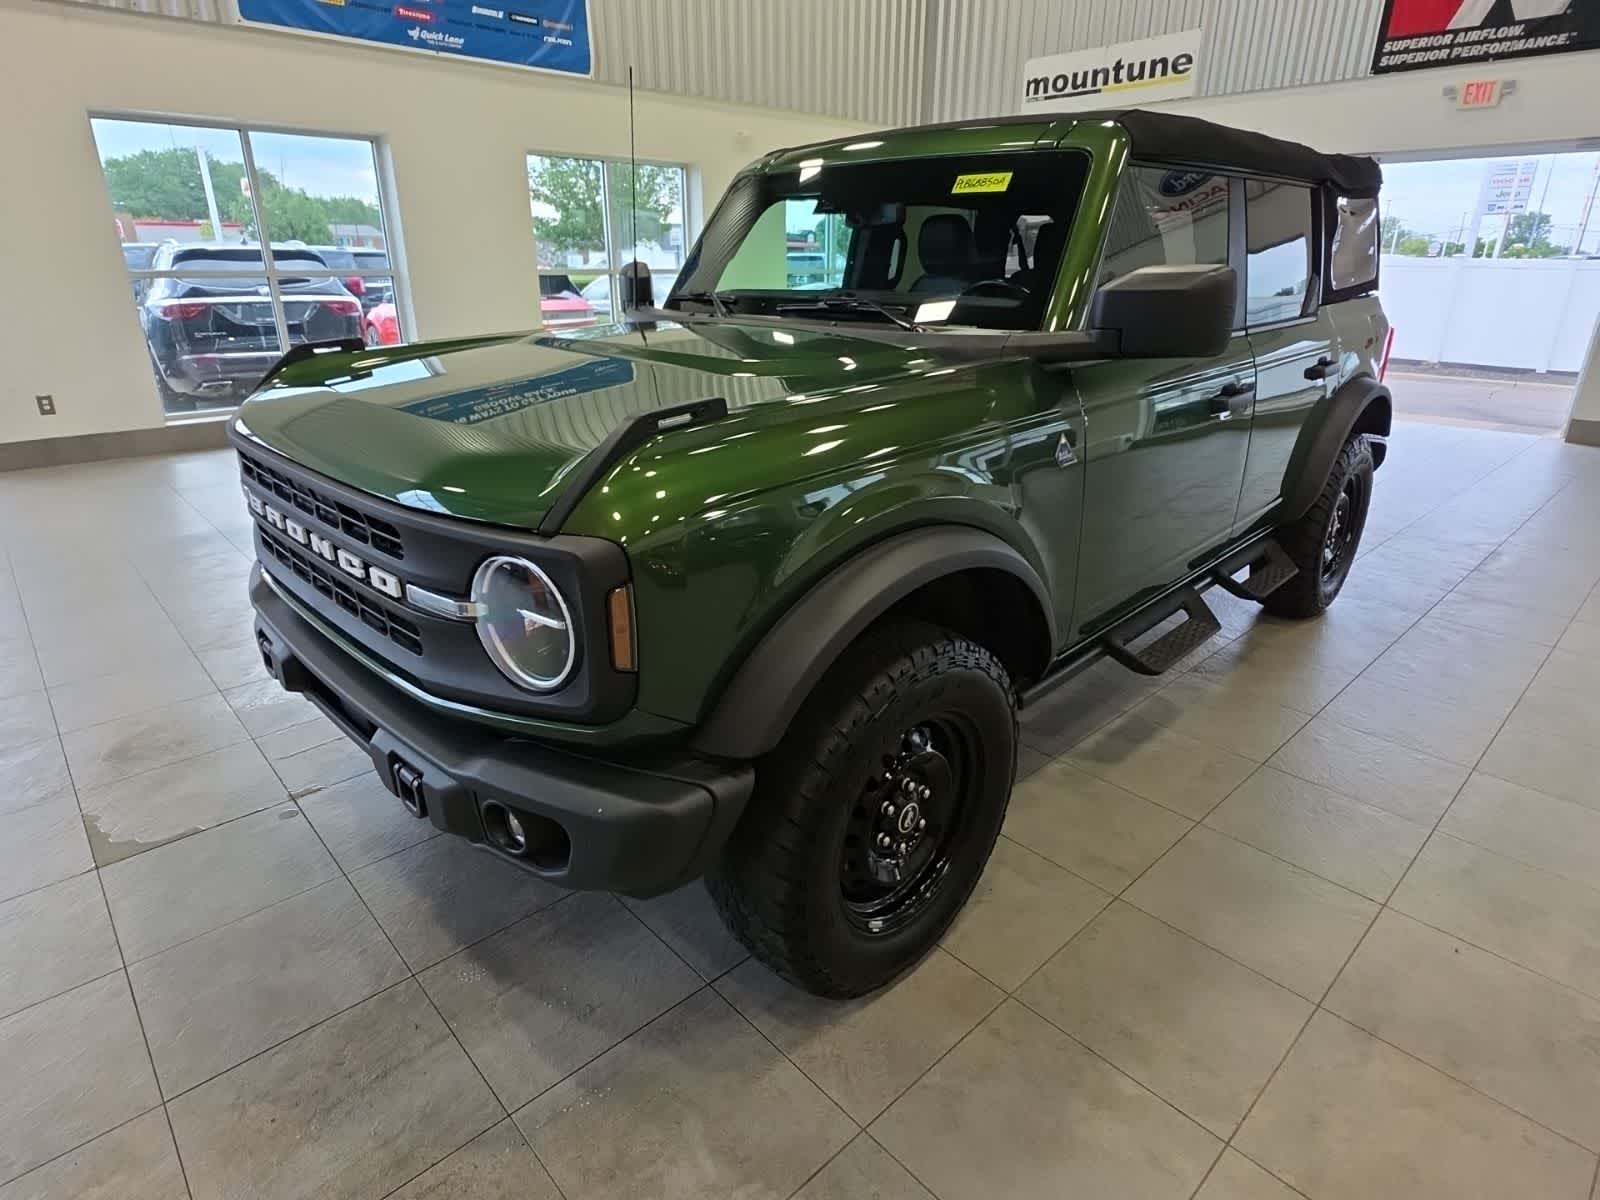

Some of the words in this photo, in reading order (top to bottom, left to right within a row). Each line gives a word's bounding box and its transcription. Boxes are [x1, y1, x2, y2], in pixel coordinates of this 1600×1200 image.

[420, 29, 444, 41] Quick
[1383, 33, 1453, 53] SUPERIOR
[1454, 24, 1525, 44] AIRFLOW.
[1379, 47, 1450, 67] SUPERIOR
[1025, 53, 1193, 97] mountune
[1463, 81, 1498, 105] EXIT
[249, 493, 402, 599] BRONCO
